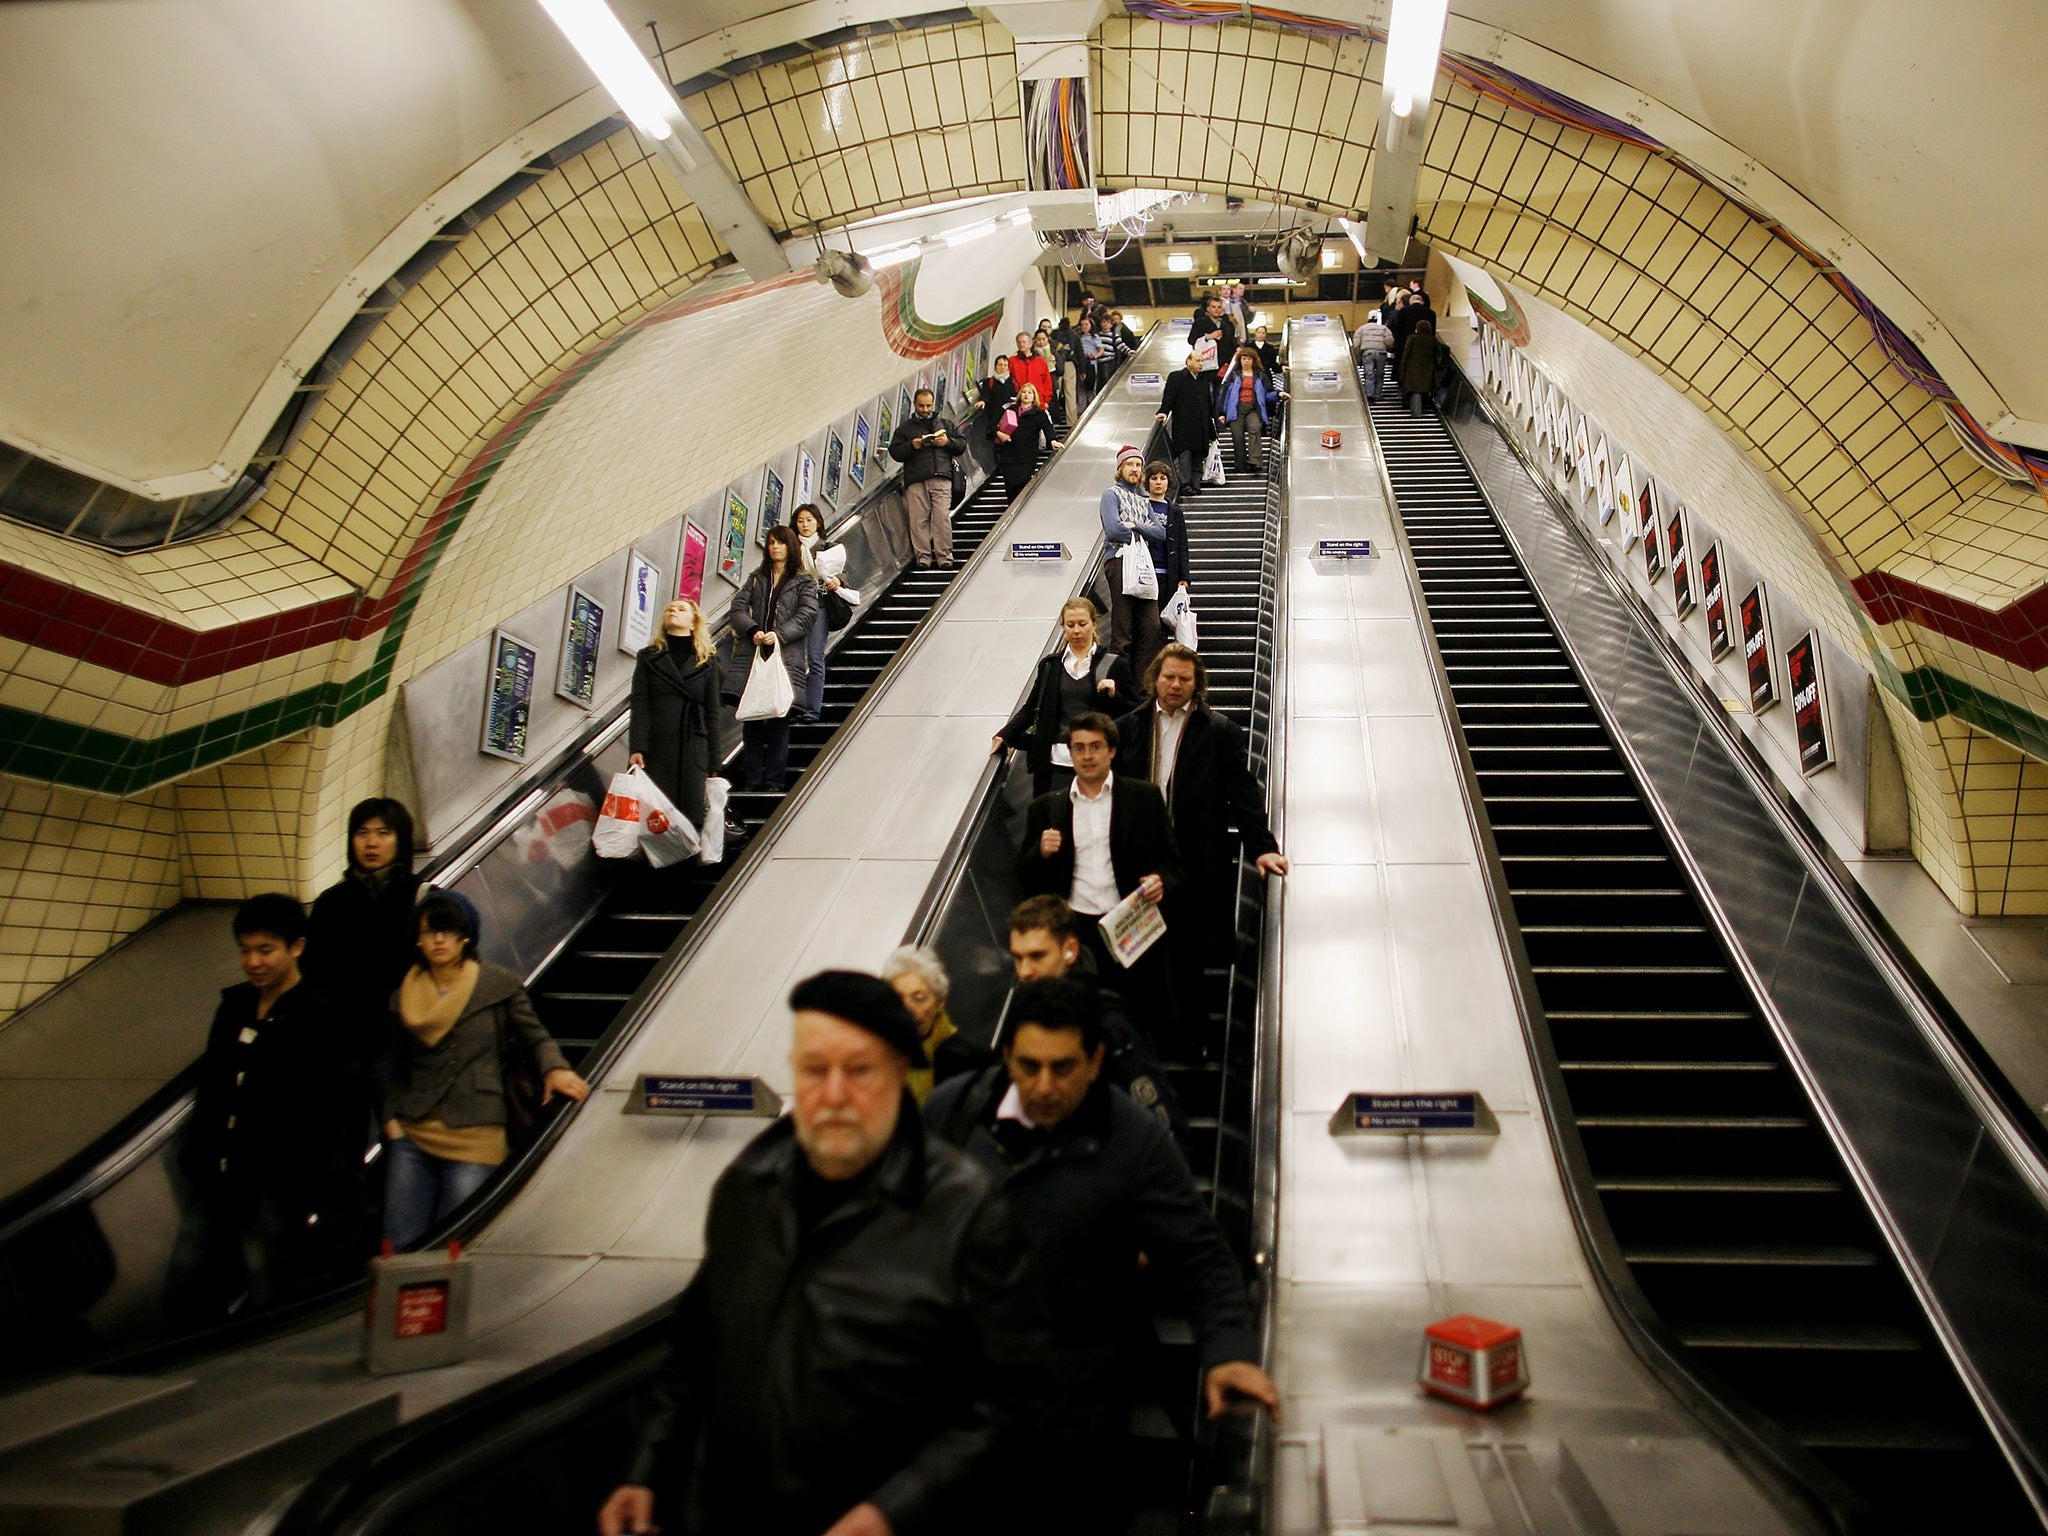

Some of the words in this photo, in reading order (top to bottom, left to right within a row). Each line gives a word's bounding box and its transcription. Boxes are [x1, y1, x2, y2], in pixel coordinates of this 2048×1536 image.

[1794, 690, 1807, 713] 50%
[1805, 681, 1816, 704] OFF
[658, 1081, 685, 1090] Stand
[686, 1082, 697, 1090] on
[699, 1082, 715, 1091] the
[716, 1082, 738, 1093] right
[660, 1097, 672, 1106] No
[673, 1097, 705, 1108] smoking
[1371, 1098, 1400, 1108] Stand
[1401, 1100, 1415, 1108] on
[1415, 1099, 1433, 1108] the
[1434, 1099, 1458, 1111] right
[1371, 1116, 1384, 1125] No
[1385, 1116, 1420, 1127] smoking
[1433, 1346, 1467, 1366] STOP
